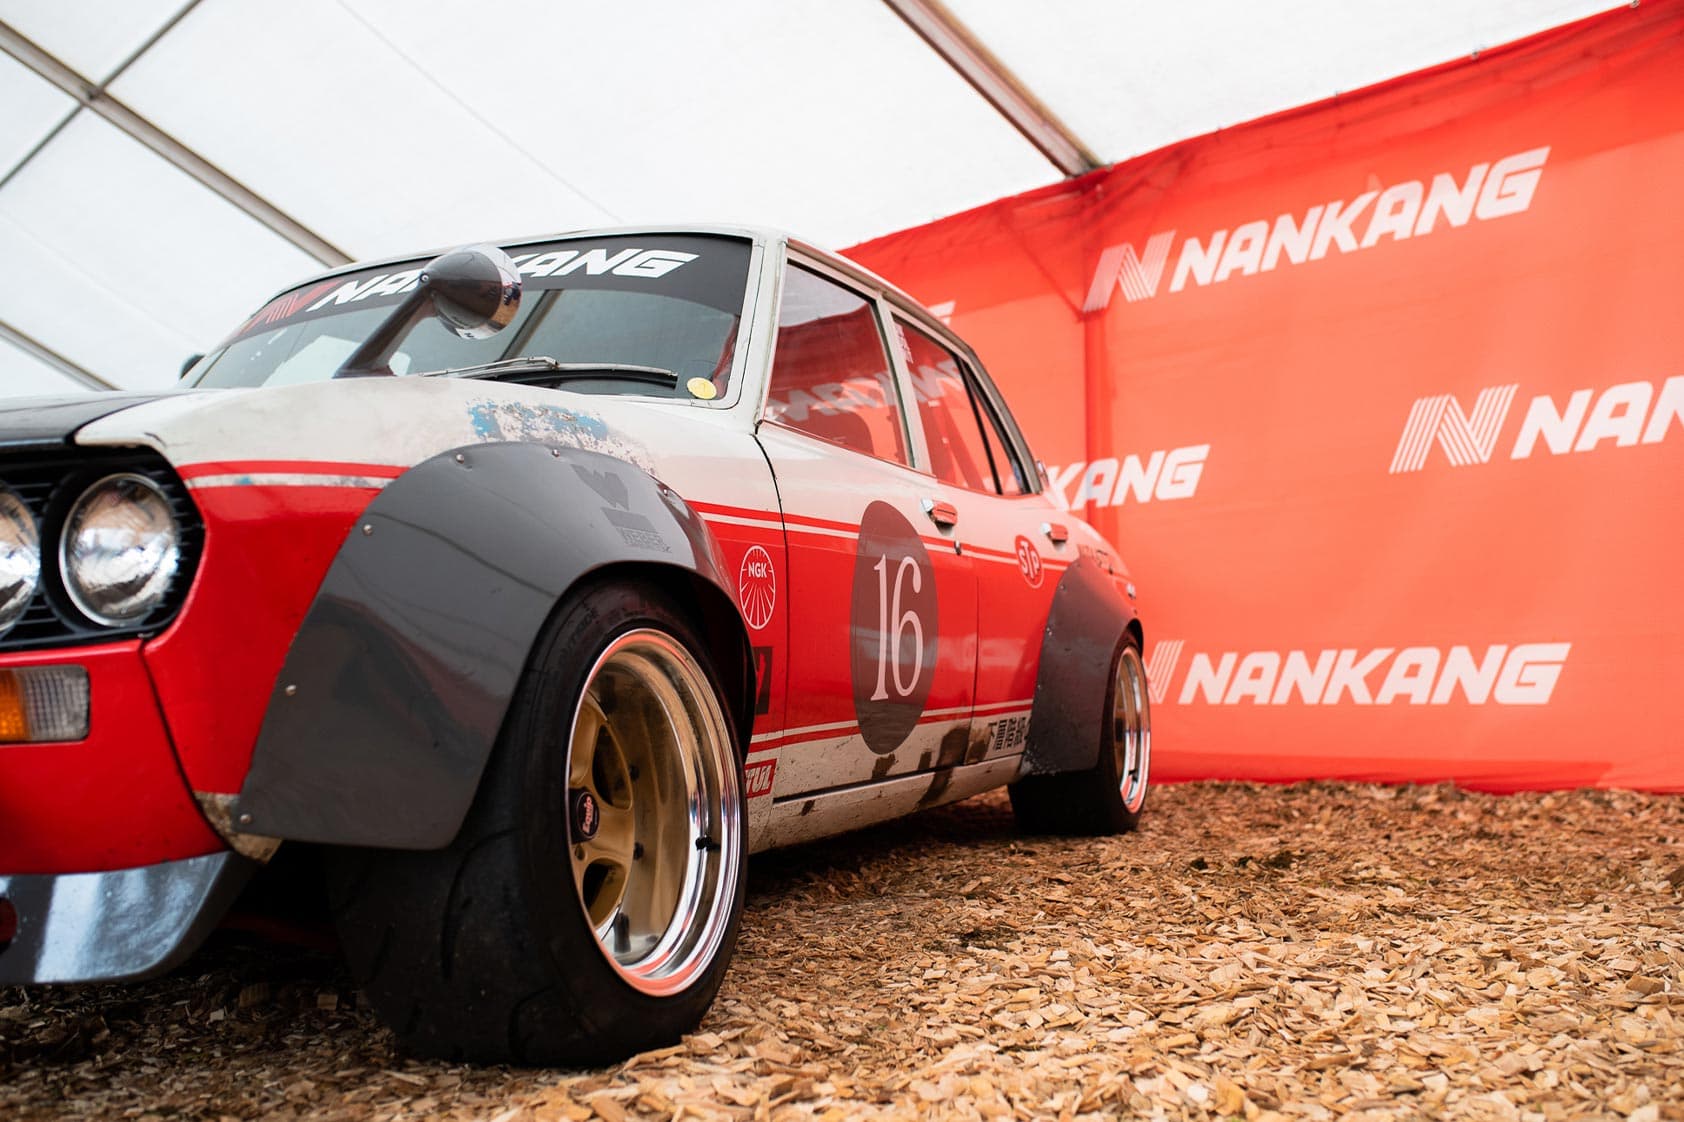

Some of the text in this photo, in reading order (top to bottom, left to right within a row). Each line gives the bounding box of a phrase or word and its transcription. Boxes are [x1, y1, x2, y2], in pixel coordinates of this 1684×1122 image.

[1168, 145, 1551, 293] NANKANG
[305, 248, 700, 313] NAANG
[748, 561, 767, 578] NGK
[1018, 541, 1040, 579] STP
[870, 553, 923, 701] 16
[1178, 642, 1572, 705] NANKANG
